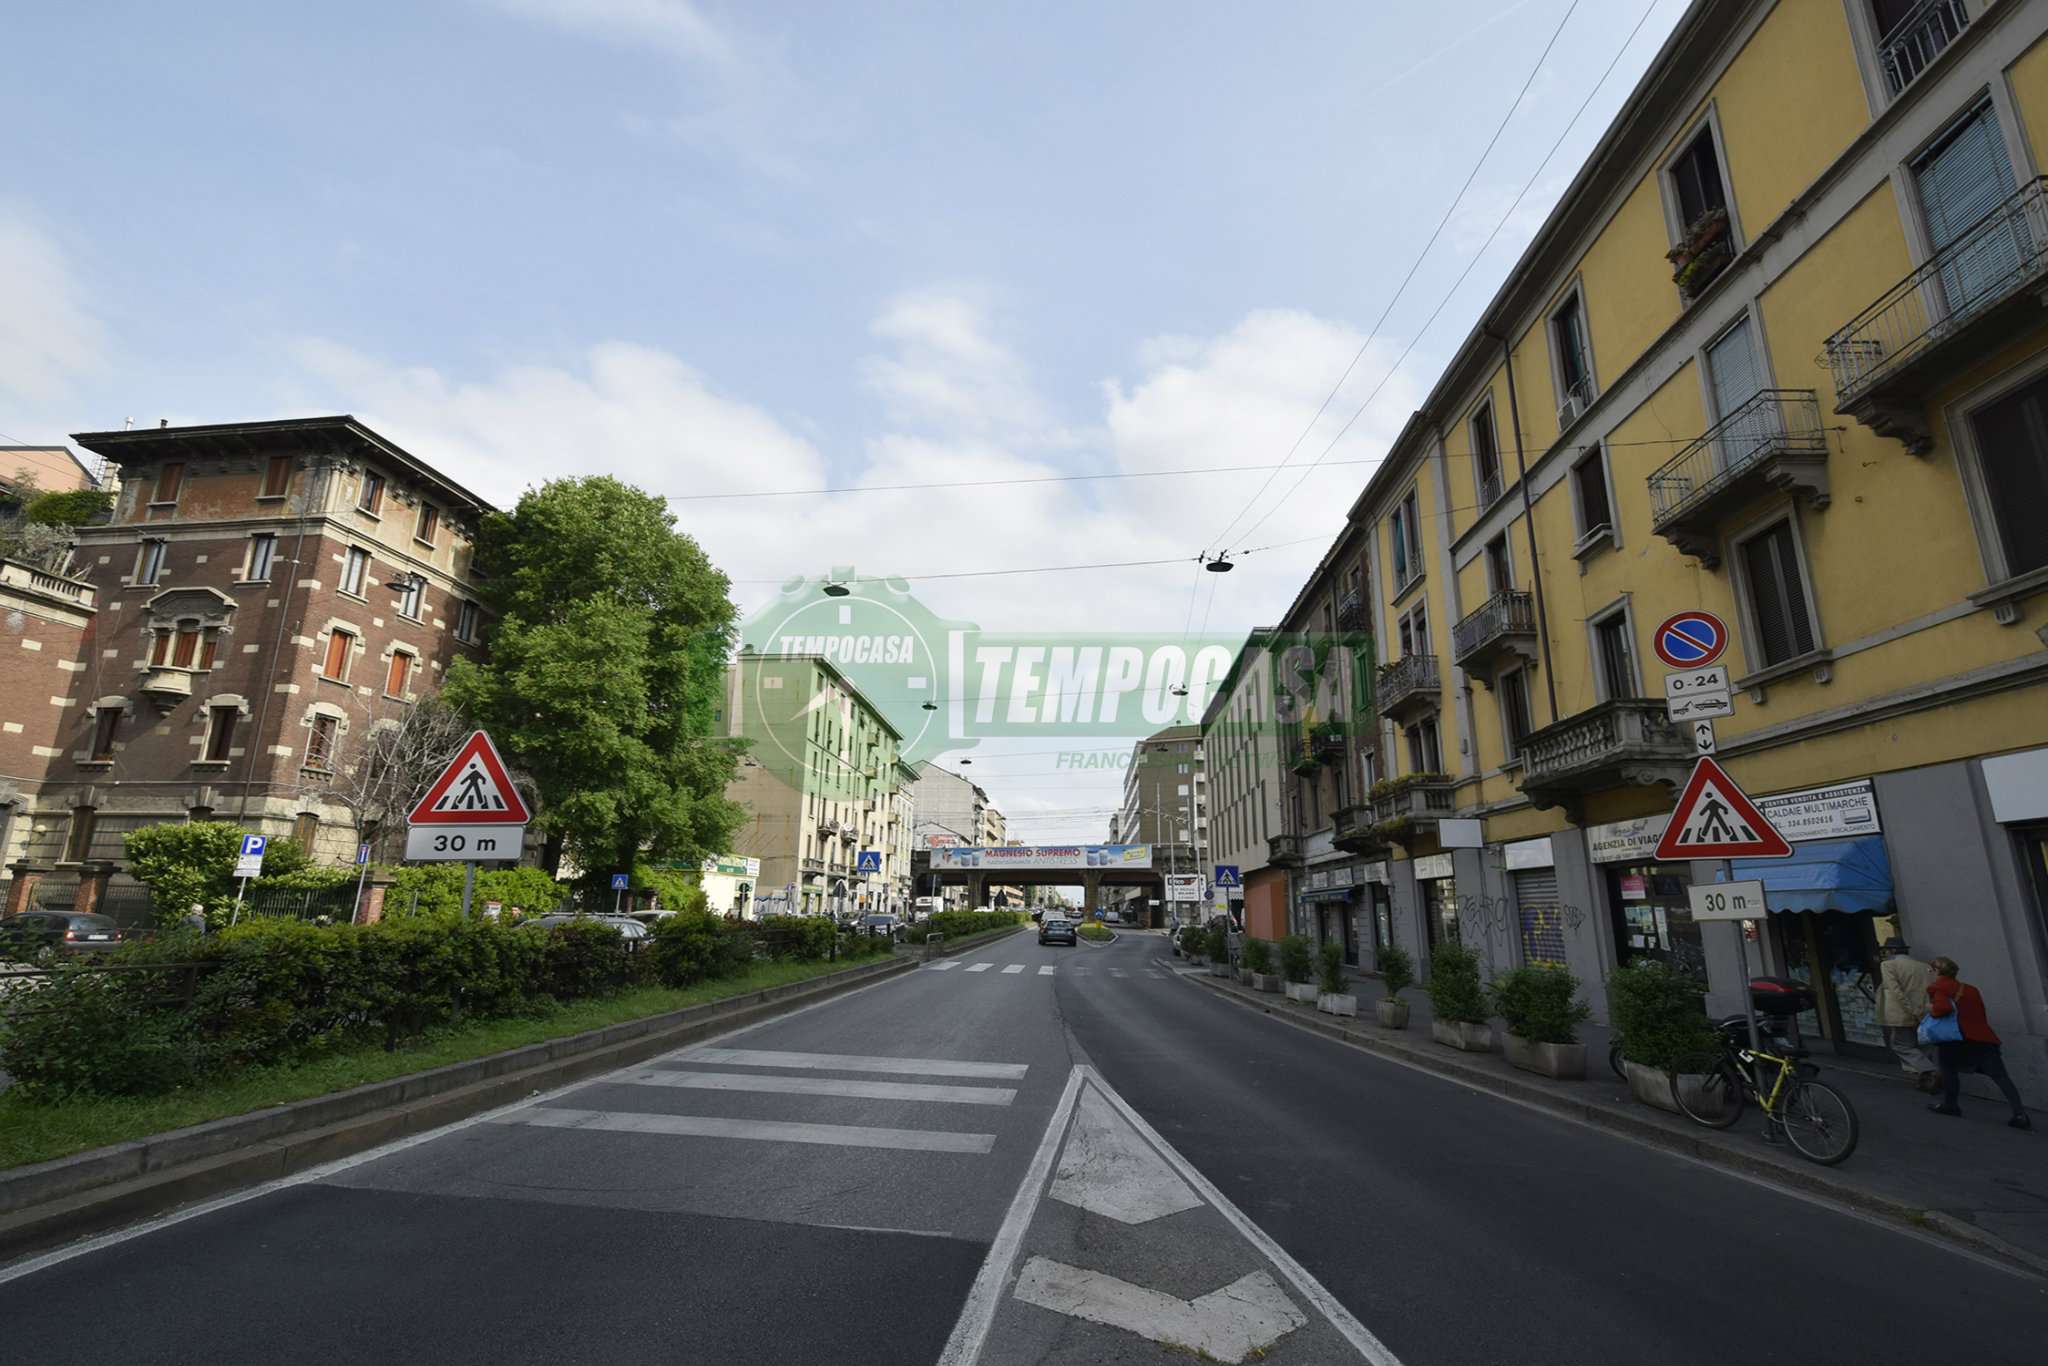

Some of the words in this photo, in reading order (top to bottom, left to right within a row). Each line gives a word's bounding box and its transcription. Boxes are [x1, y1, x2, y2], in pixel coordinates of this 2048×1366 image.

[1695, 674, 1719, 687] 24
[1791, 794, 1817, 804] VENDITA
[1824, 787, 1867, 798] ASSISTENZA
[1767, 807, 1802, 819] CALDAIE
[1803, 796, 1869, 813] MULTIMARCHE
[245, 837, 264, 854] P
[433, 835, 466, 852] 30
[476, 838, 497, 851] m
[1592, 839, 1626, 851] AGENZIA
[1627, 838, 1636, 846] DI
[984, 849, 1033, 858] MAGNESIO
[1035, 847, 1081, 857] SUPREMO
[1705, 893, 1726, 911] 30
[1732, 895, 1746, 910] m
